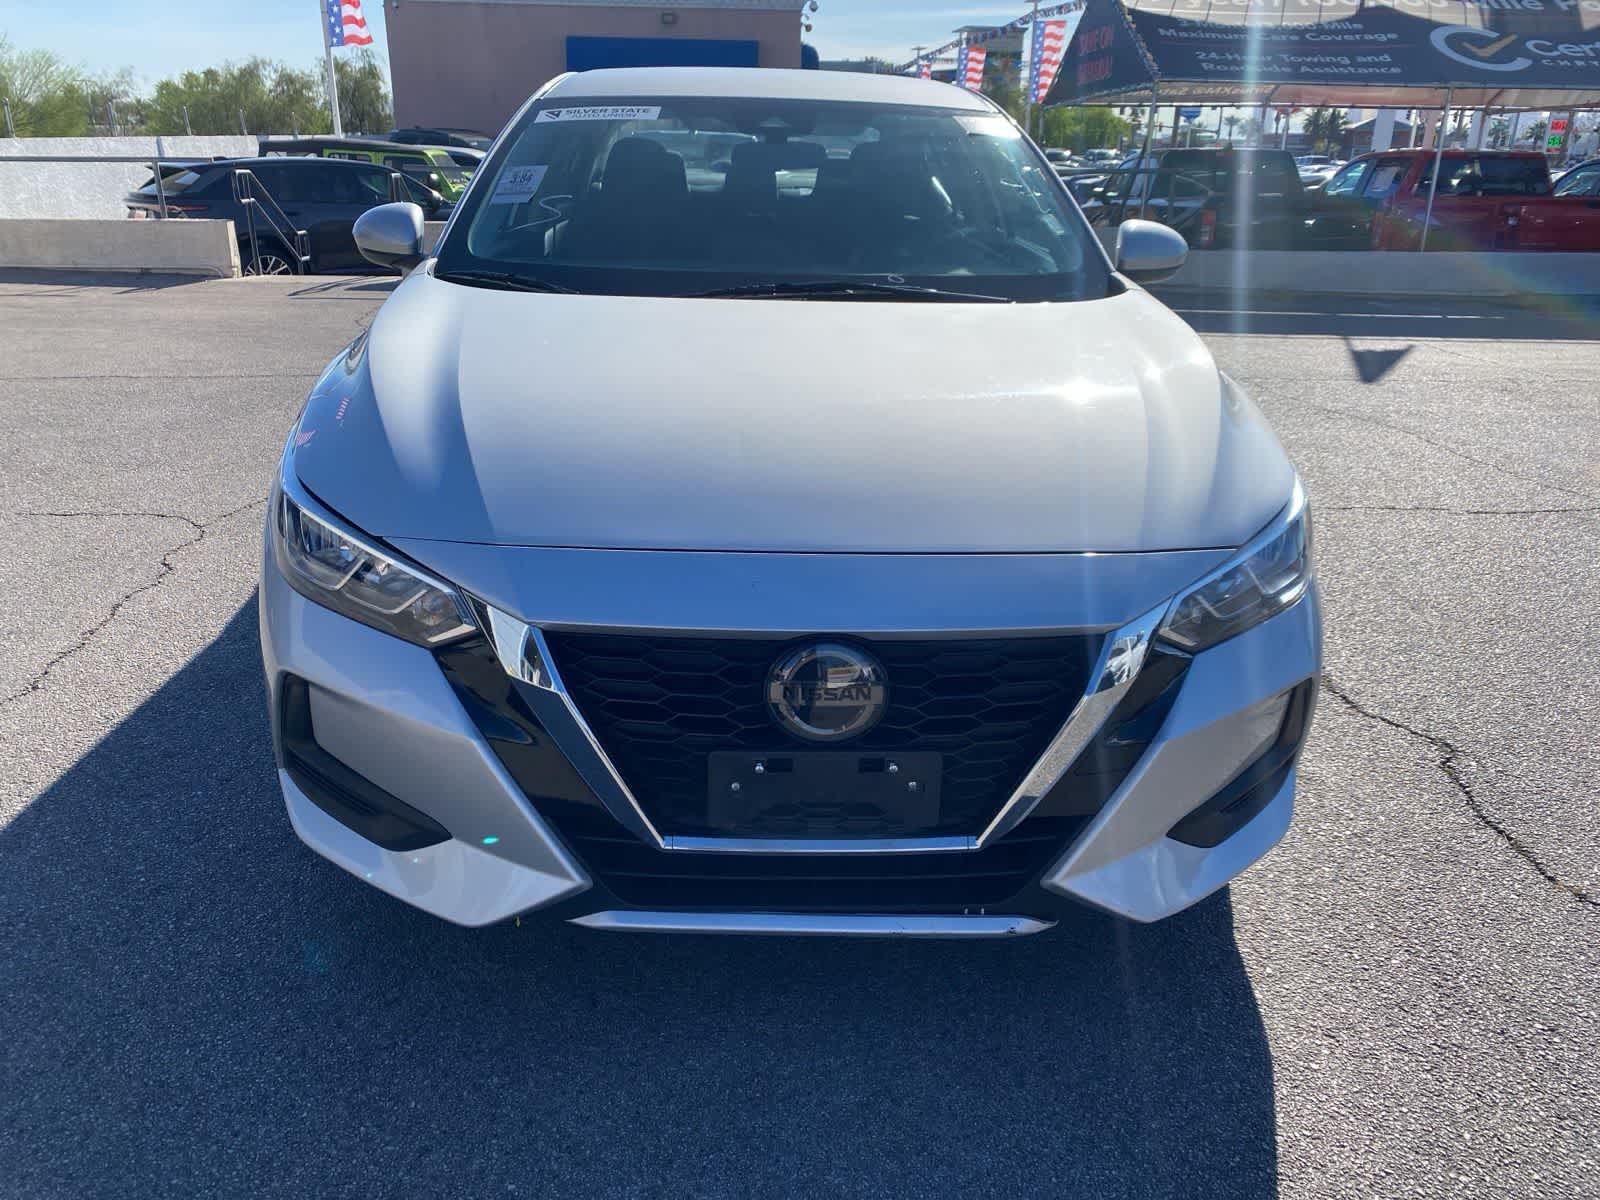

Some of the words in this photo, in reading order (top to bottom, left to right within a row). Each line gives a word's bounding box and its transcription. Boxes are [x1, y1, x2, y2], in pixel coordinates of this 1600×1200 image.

[1158, 28, 1249, 41] Maximum
[1256, 32, 1299, 41] Care
[1305, 32, 1400, 42] Coverage
[1281, 54, 1351, 65] Towing
[1356, 53, 1393, 62] and
[1300, 65, 1402, 74] Assistance
[611, 106, 649, 114] STATE
[783, 686, 871, 701] NISSAN
